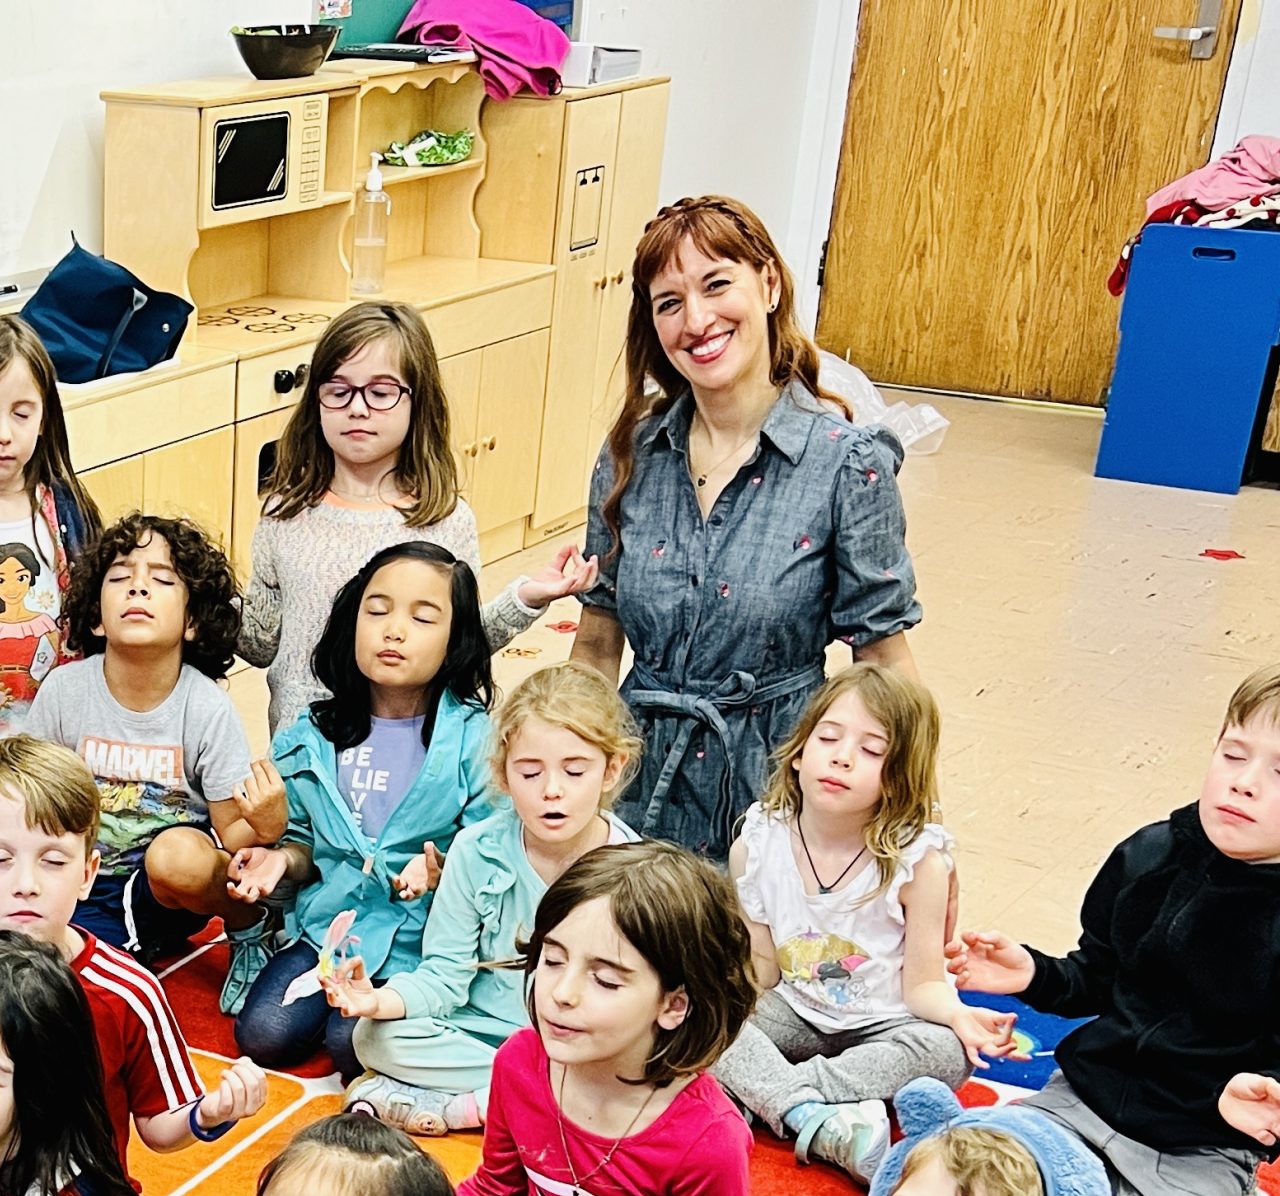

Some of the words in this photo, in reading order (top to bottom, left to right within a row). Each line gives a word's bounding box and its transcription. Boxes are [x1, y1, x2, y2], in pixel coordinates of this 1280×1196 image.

[84, 740, 180, 786] MARVEL
[340, 747, 373, 767] BE
[352, 769, 390, 792] LIE
[350, 791, 367, 811] V
